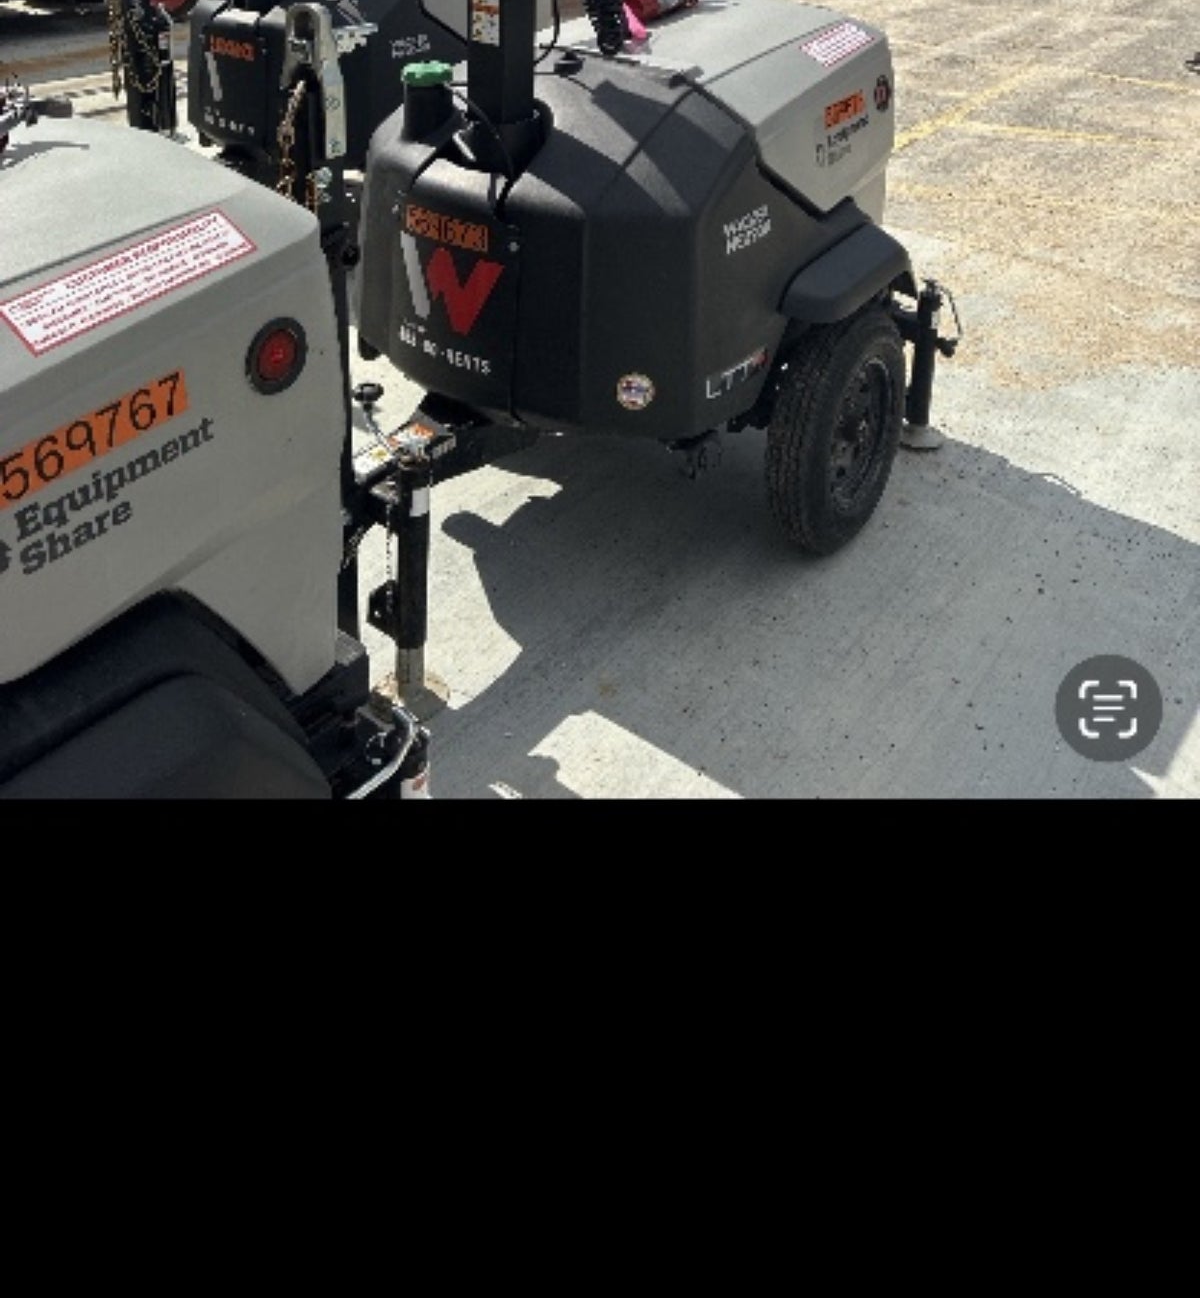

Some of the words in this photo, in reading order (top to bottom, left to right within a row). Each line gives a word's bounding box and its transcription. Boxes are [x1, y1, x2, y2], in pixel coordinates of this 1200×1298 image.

[0, 371, 180, 500] 569767
[14, 417, 215, 542] Equipment
[20, 502, 132, 575] Share
